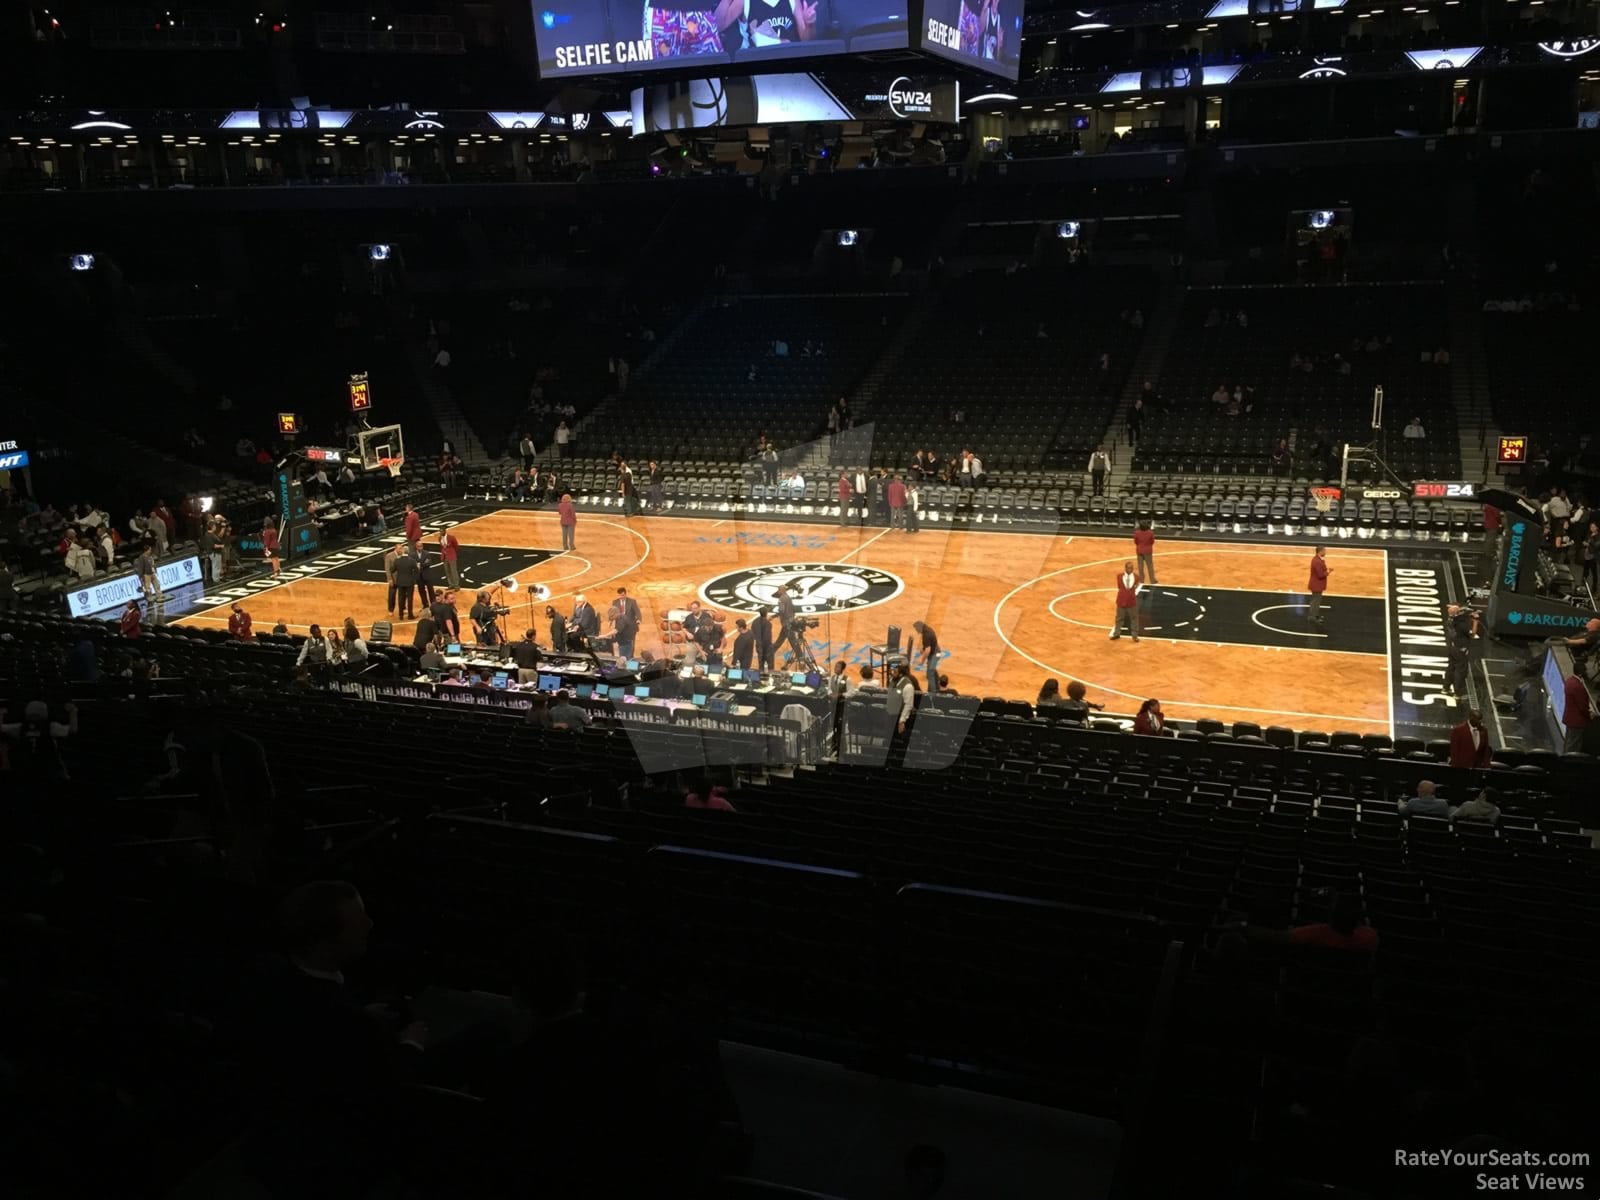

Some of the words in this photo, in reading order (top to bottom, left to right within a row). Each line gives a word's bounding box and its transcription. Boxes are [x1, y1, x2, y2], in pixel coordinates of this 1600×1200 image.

[928, 18, 947, 46] SELFIE
[947, 26, 960, 50] CAM
[555, 43, 611, 68] SELFIE
[616, 40, 654, 62] CAM
[891, 91, 932, 106] SW24
[354, 392, 367, 407] 24
[307, 449, 341, 461] SW24
[1503, 448, 1519, 459] 24
[1363, 490, 1401, 499] GEICO
[1415, 484, 1474, 497] SW24
[1504, 535, 1522, 585] BARCLAYS
[194, 546, 384, 604] BROOKLYN
[1395, 568, 1447, 647] BROOKLYN
